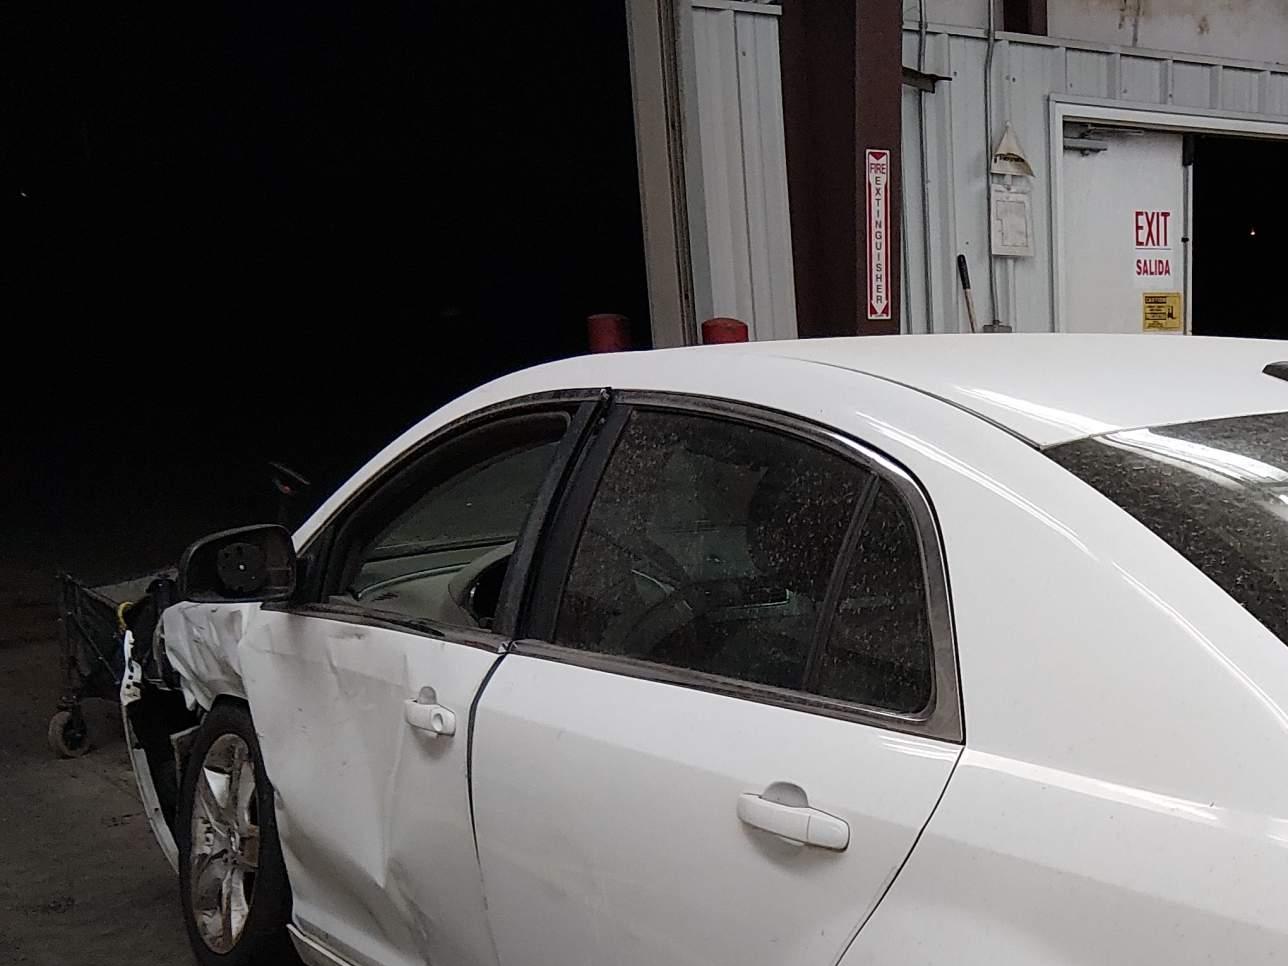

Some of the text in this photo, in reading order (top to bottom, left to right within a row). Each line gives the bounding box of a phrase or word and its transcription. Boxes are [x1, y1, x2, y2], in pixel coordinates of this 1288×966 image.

[870, 163, 886, 174] FIRE
[1135, 211, 1170, 246] EXIT
[1136, 260, 1170, 276] SALIDA
